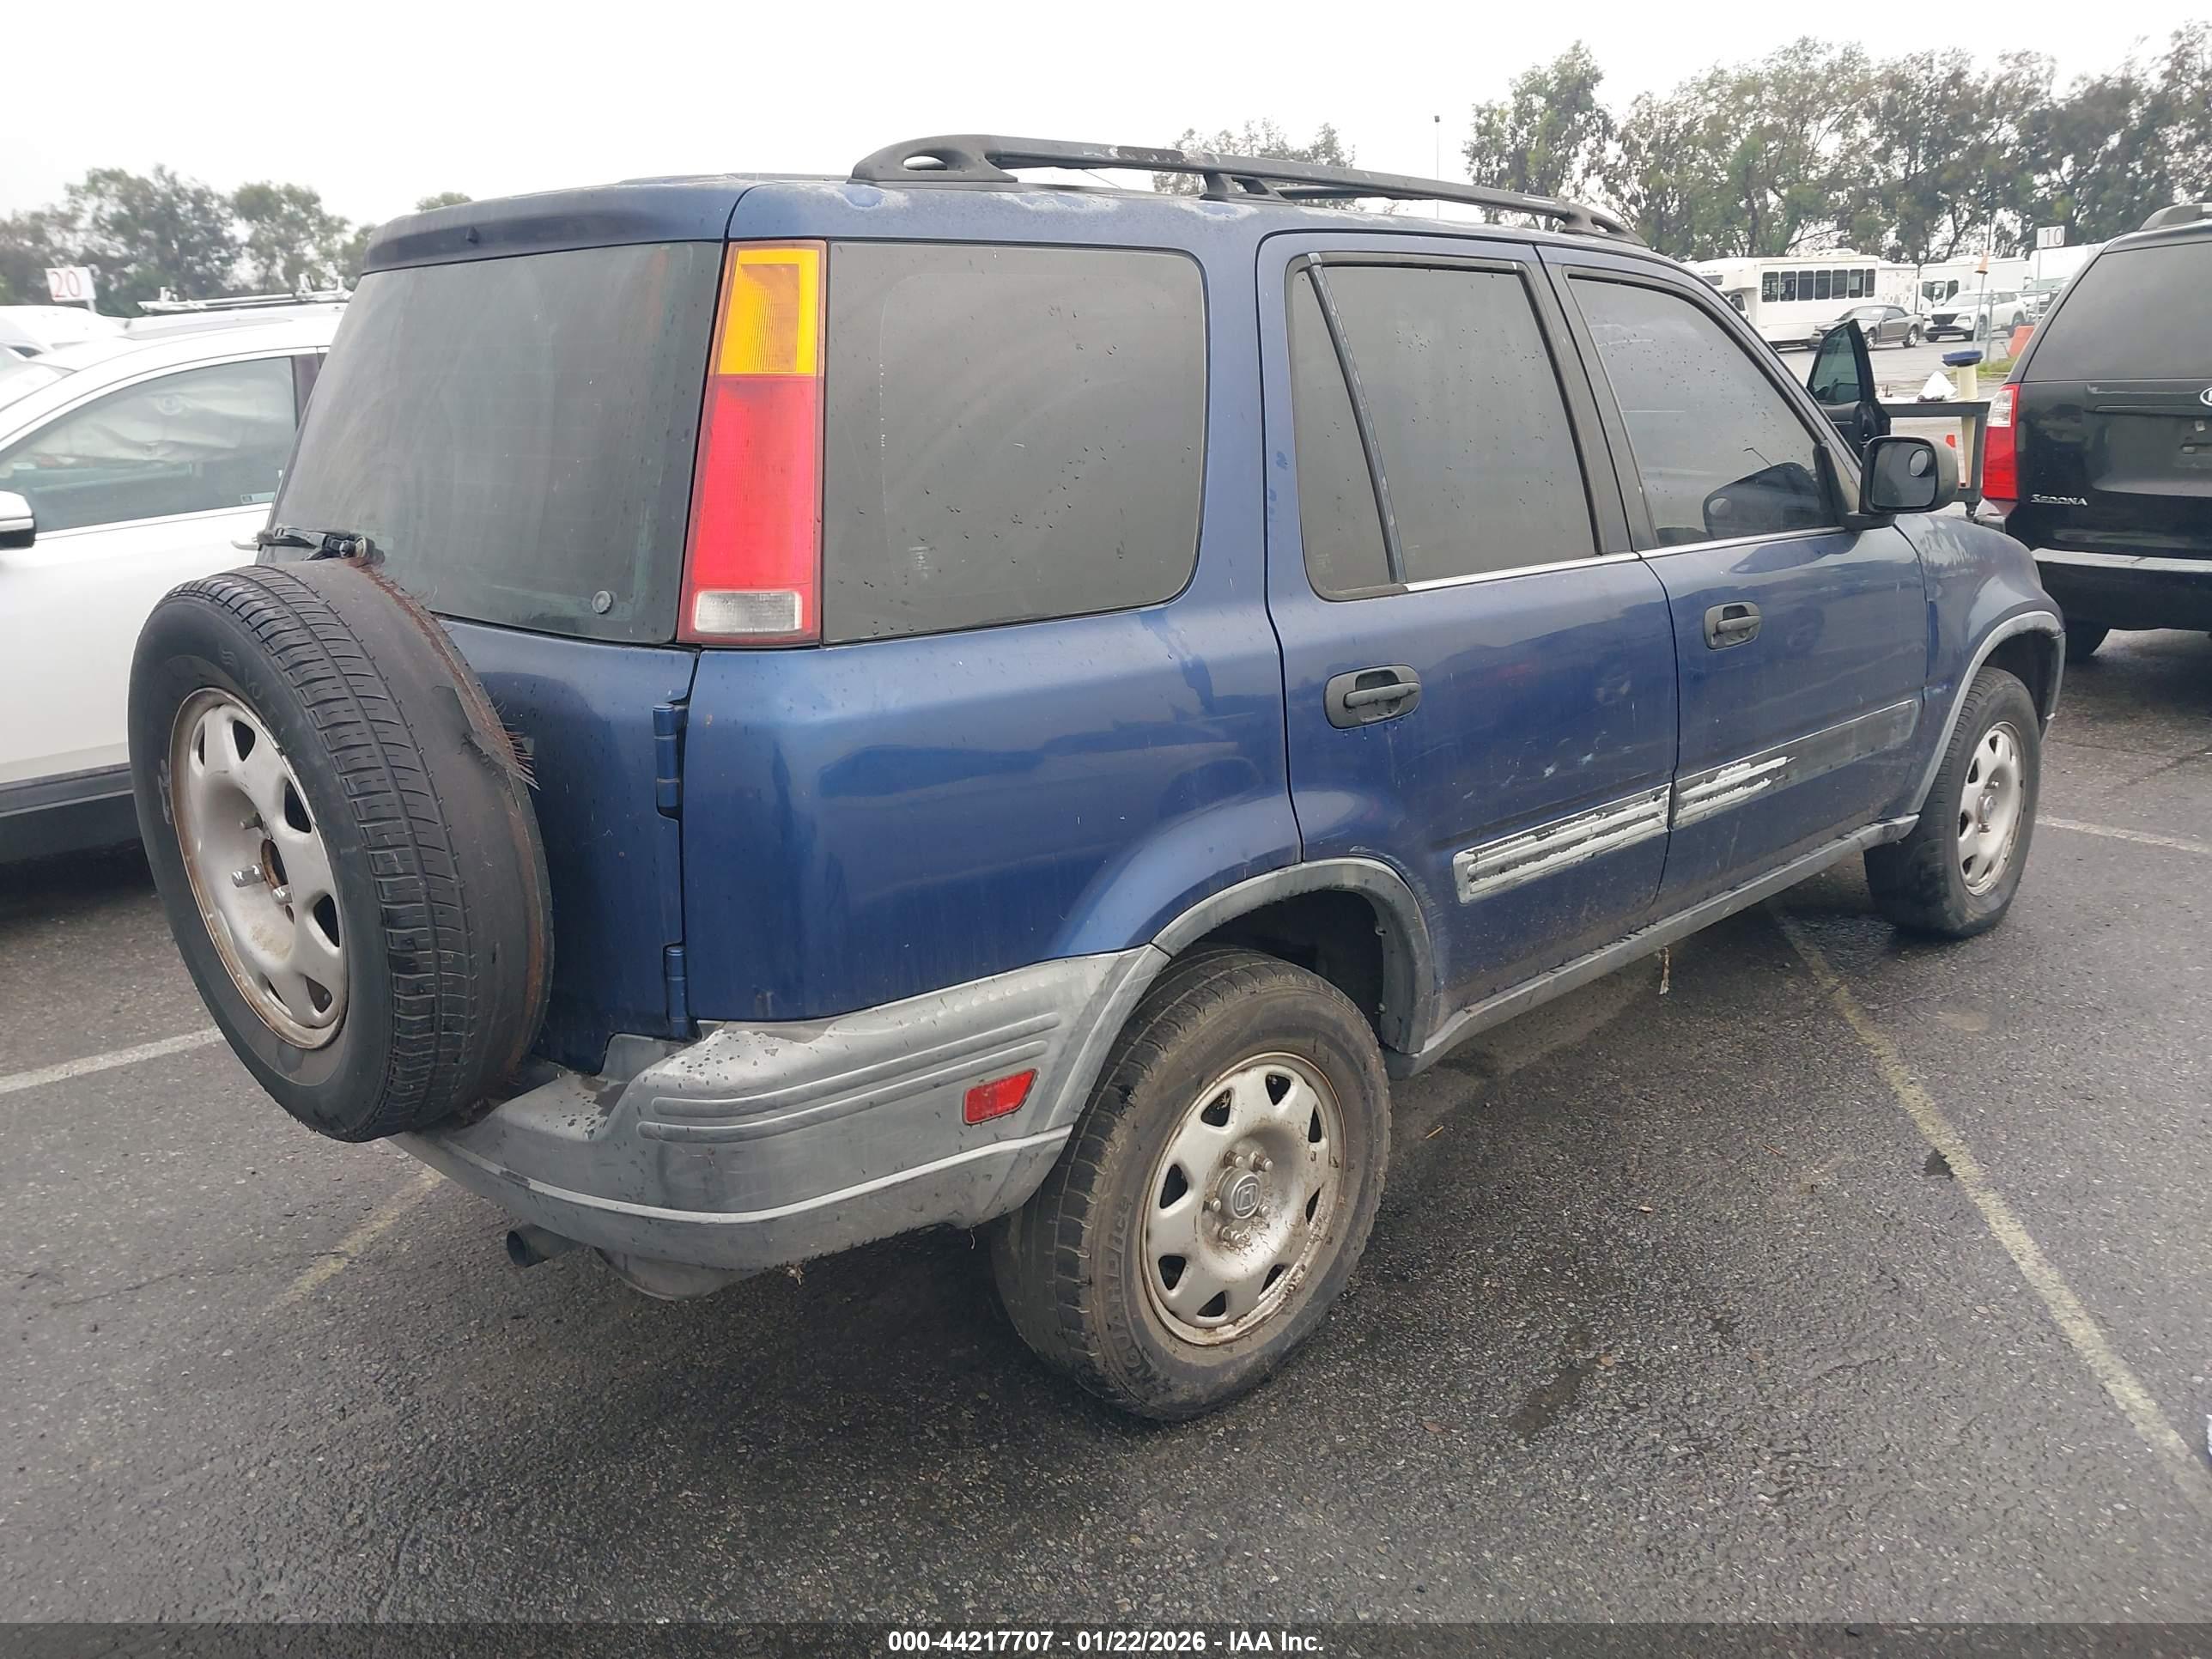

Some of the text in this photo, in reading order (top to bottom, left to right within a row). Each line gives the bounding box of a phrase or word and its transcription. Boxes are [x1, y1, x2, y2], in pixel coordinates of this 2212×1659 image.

[2045, 228, 2063, 246] 10
[51, 270, 82, 298] 20
[2030, 494, 2087, 506] SEDONA
